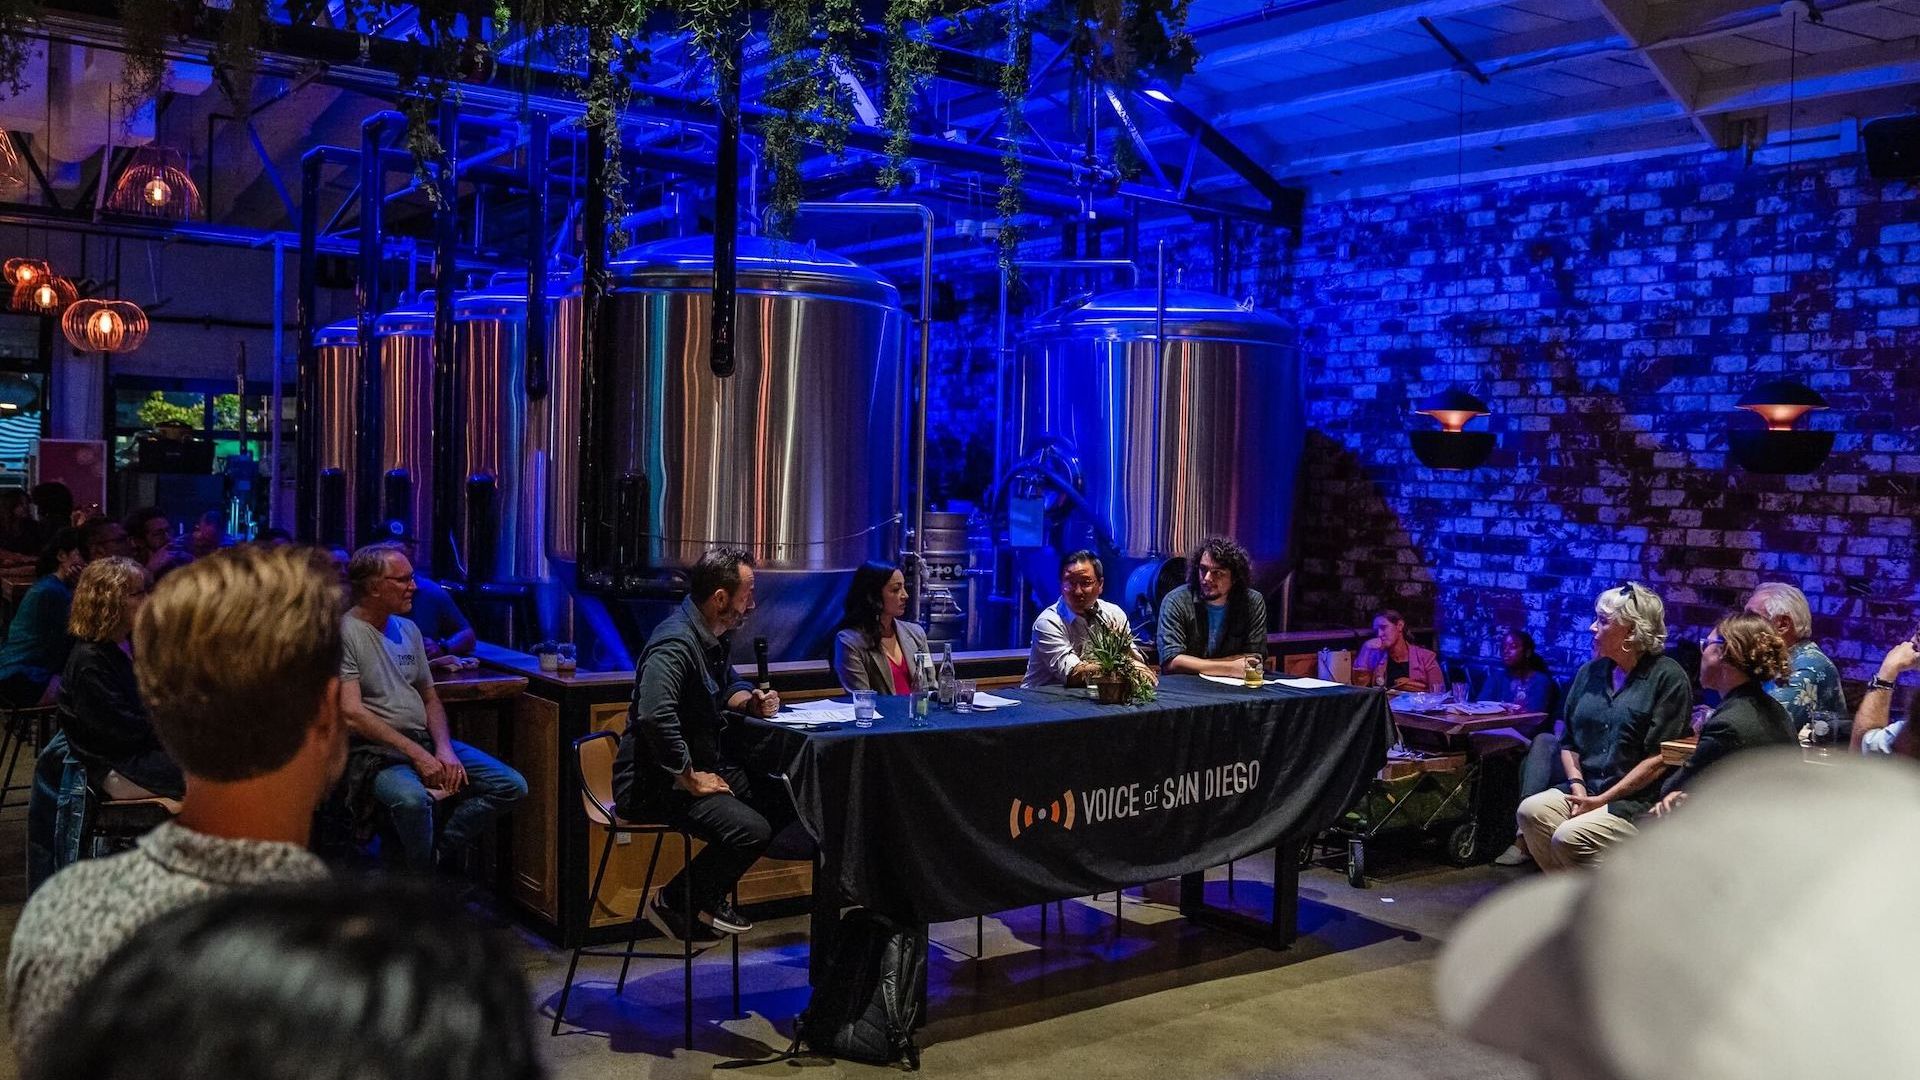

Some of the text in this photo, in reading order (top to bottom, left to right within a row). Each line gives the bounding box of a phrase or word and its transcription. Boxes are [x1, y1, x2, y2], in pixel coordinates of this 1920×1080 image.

[1082, 759, 1260, 825] VOICE of SAN DIEGO
